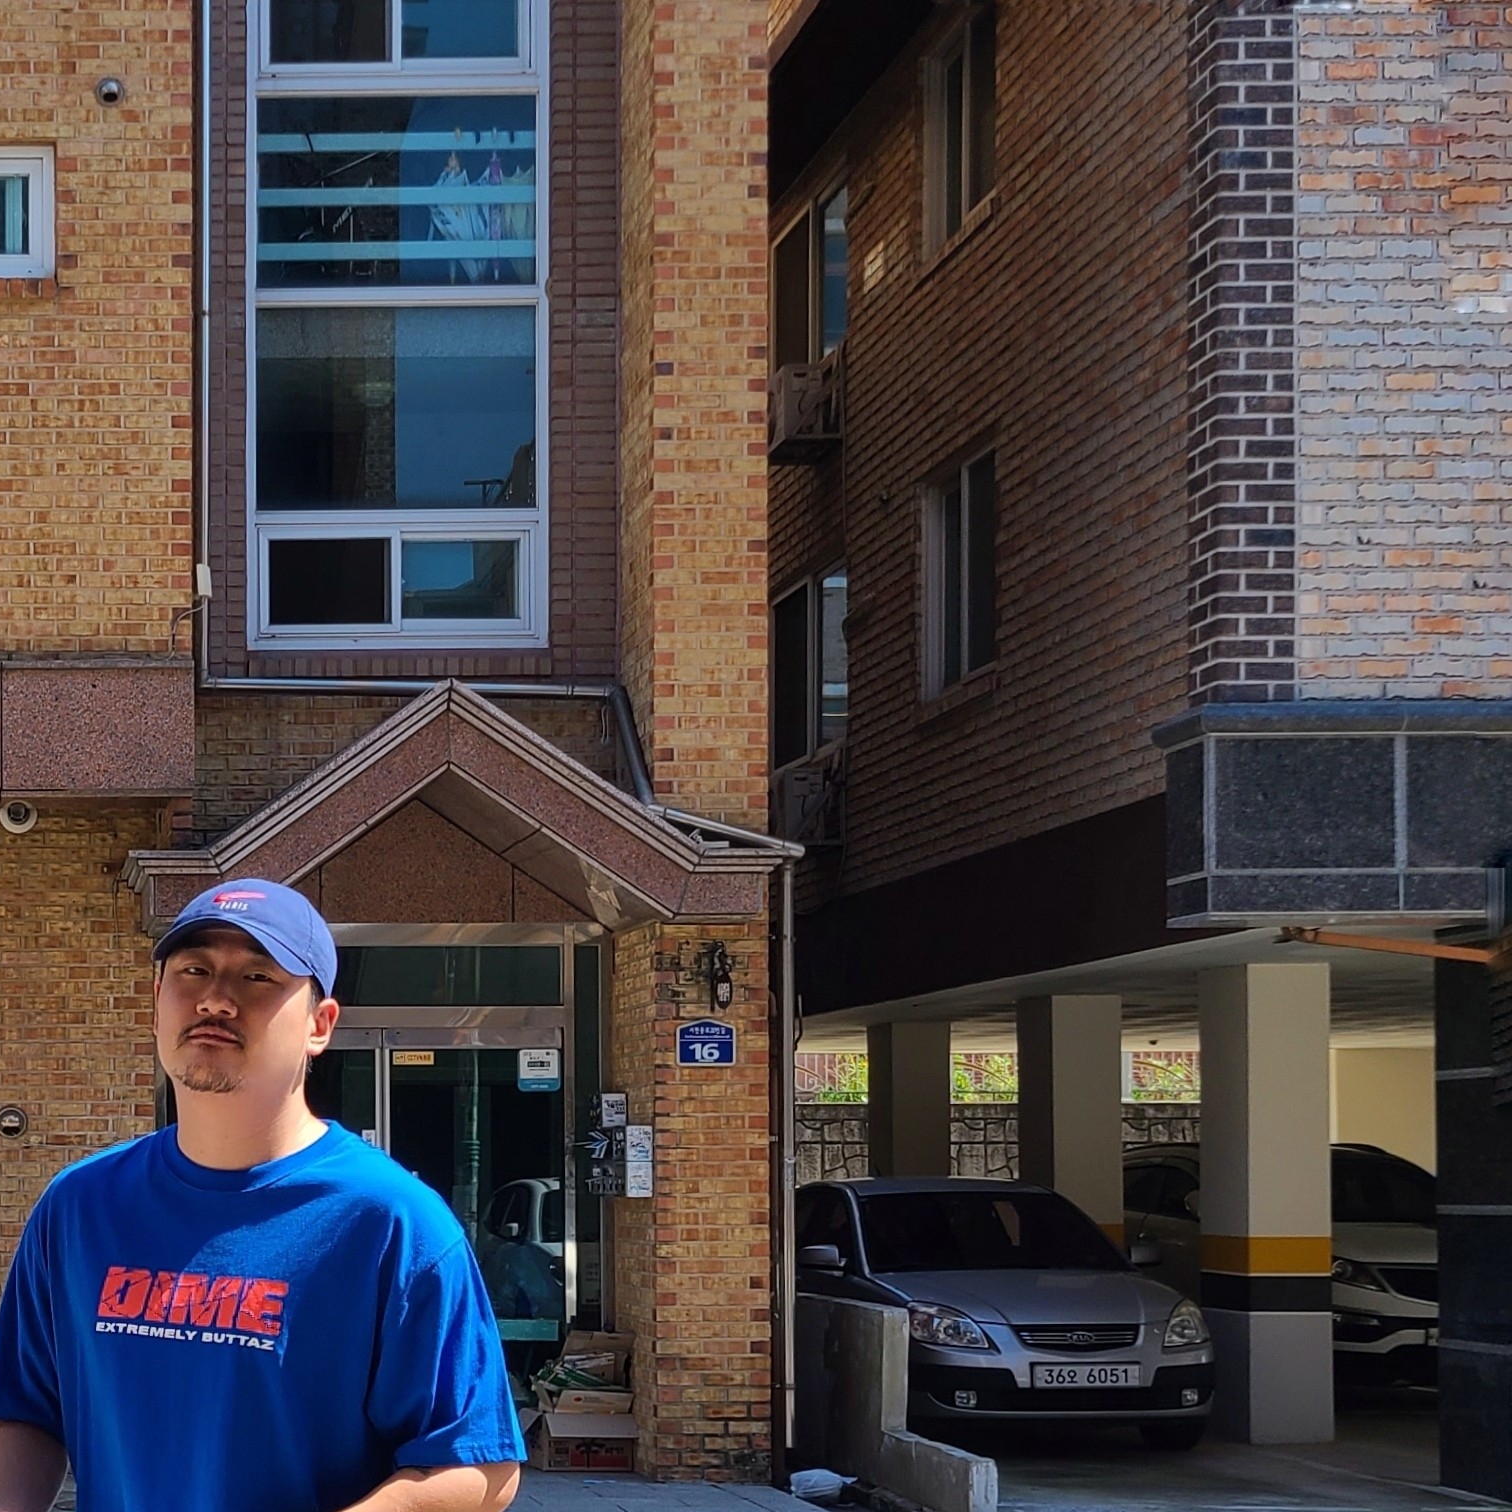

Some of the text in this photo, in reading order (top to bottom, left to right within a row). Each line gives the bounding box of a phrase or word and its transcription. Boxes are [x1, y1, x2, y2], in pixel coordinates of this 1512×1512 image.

[688, 1043, 720, 1060] 16
[98, 1265, 289, 1336] DIME
[95, 1321, 275, 1351] EXTREMELY BUTTAZ
[1044, 1367, 1128, 1384] 36오 6051
